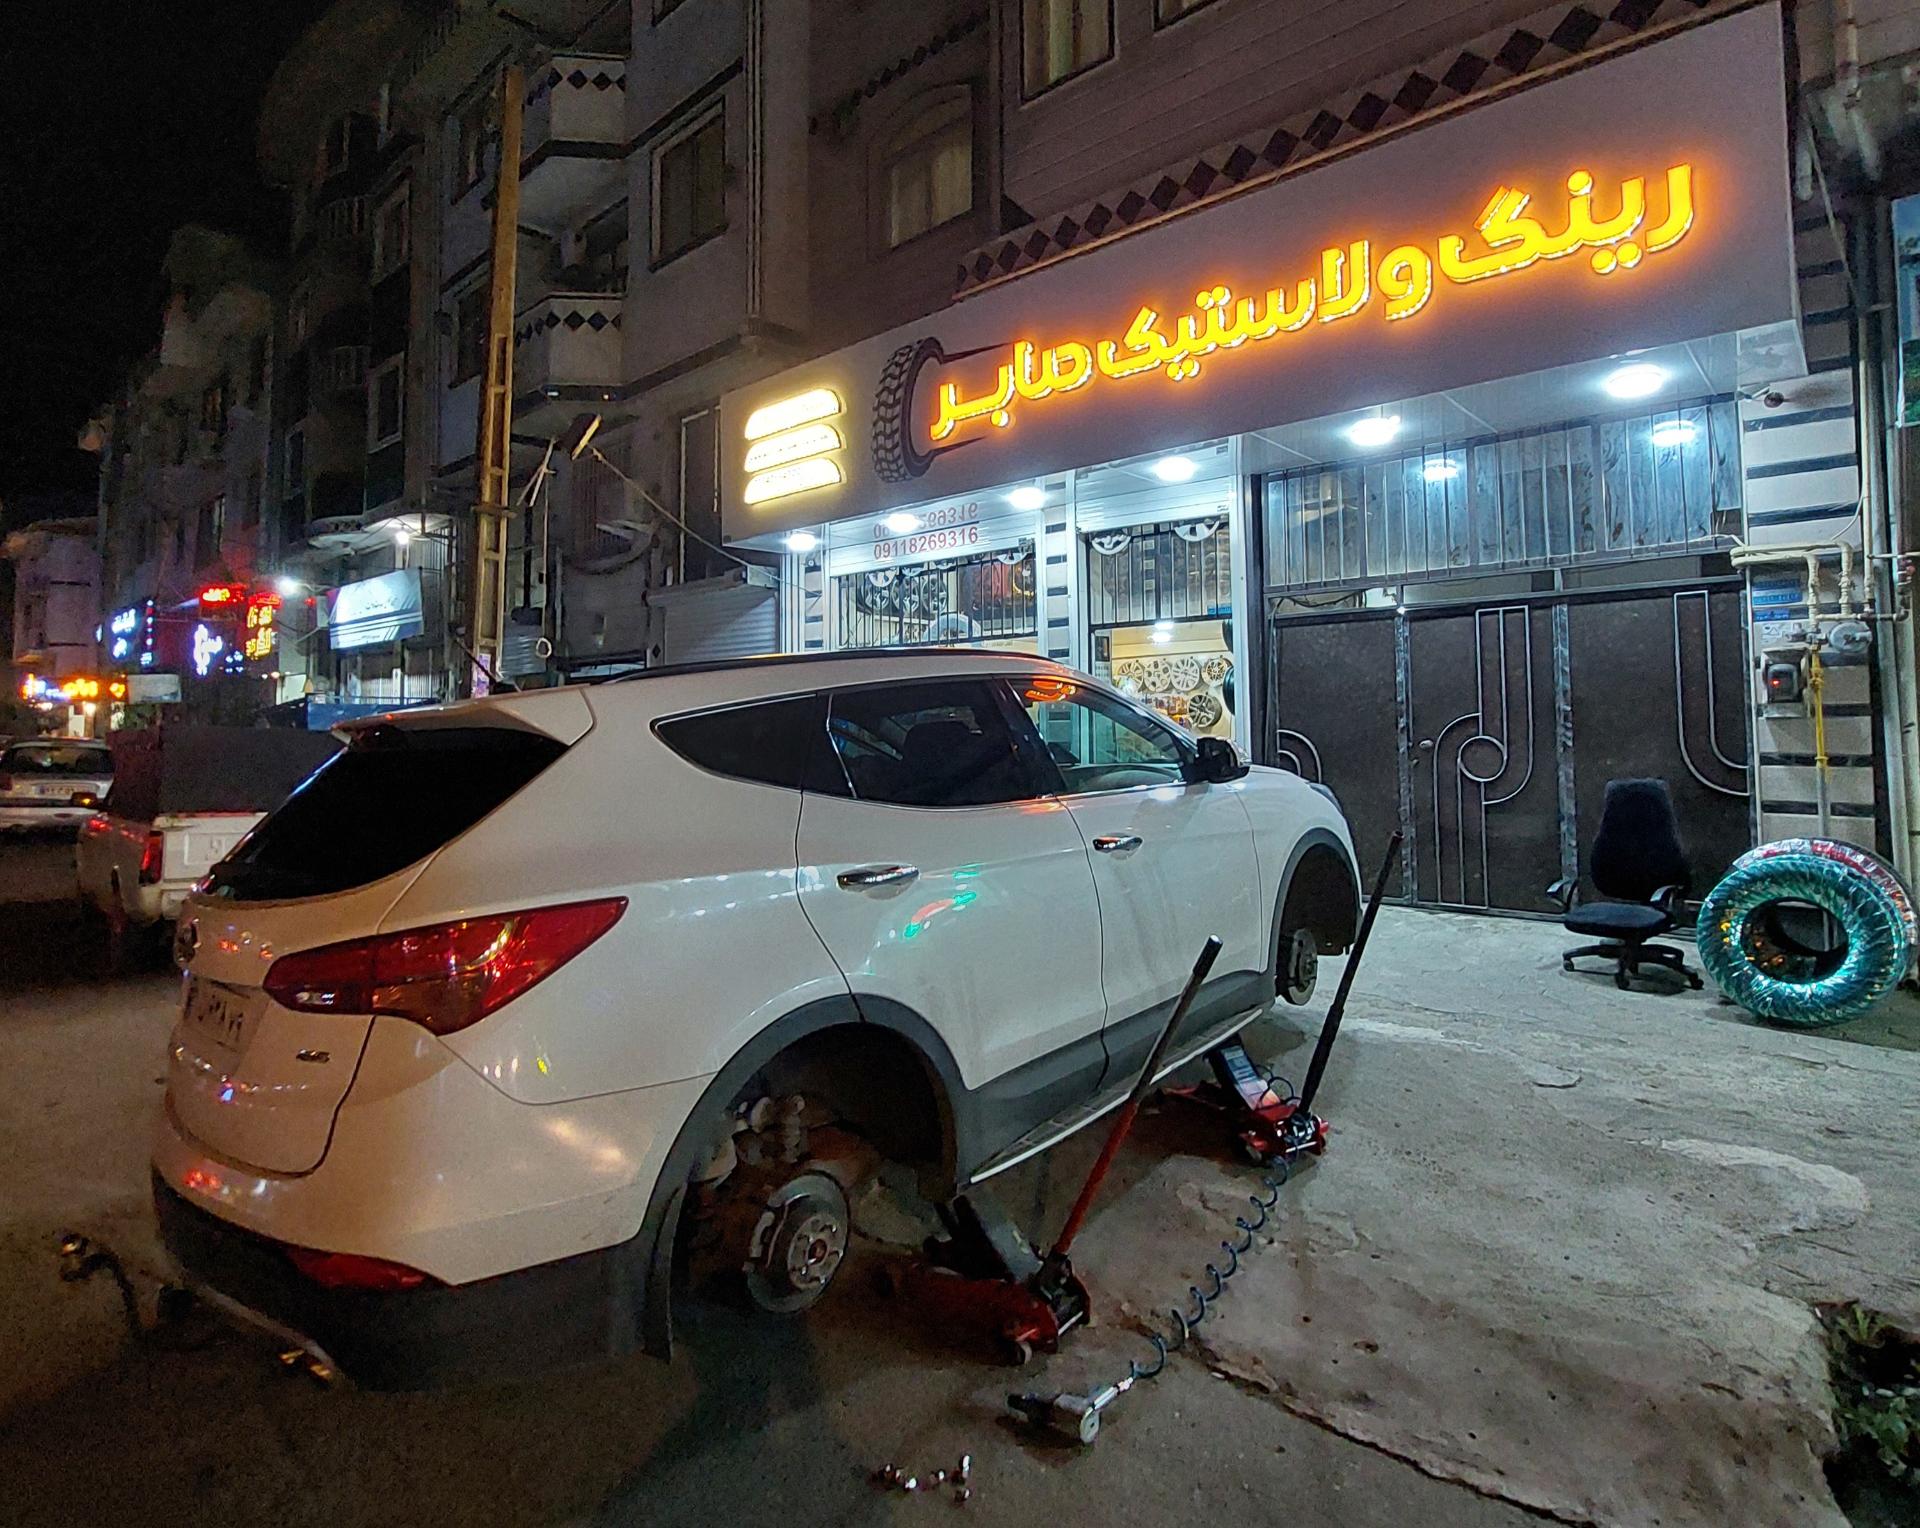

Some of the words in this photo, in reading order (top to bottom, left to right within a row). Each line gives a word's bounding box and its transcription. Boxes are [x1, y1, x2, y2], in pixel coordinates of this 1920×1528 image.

[1438, 162, 1695, 283] رینگ
[1104, 239, 1371, 382] لاستیک
[1377, 244, 1433, 322] و
[930, 339, 1094, 440] صابر
[873, 526, 979, 560] 09118269316
